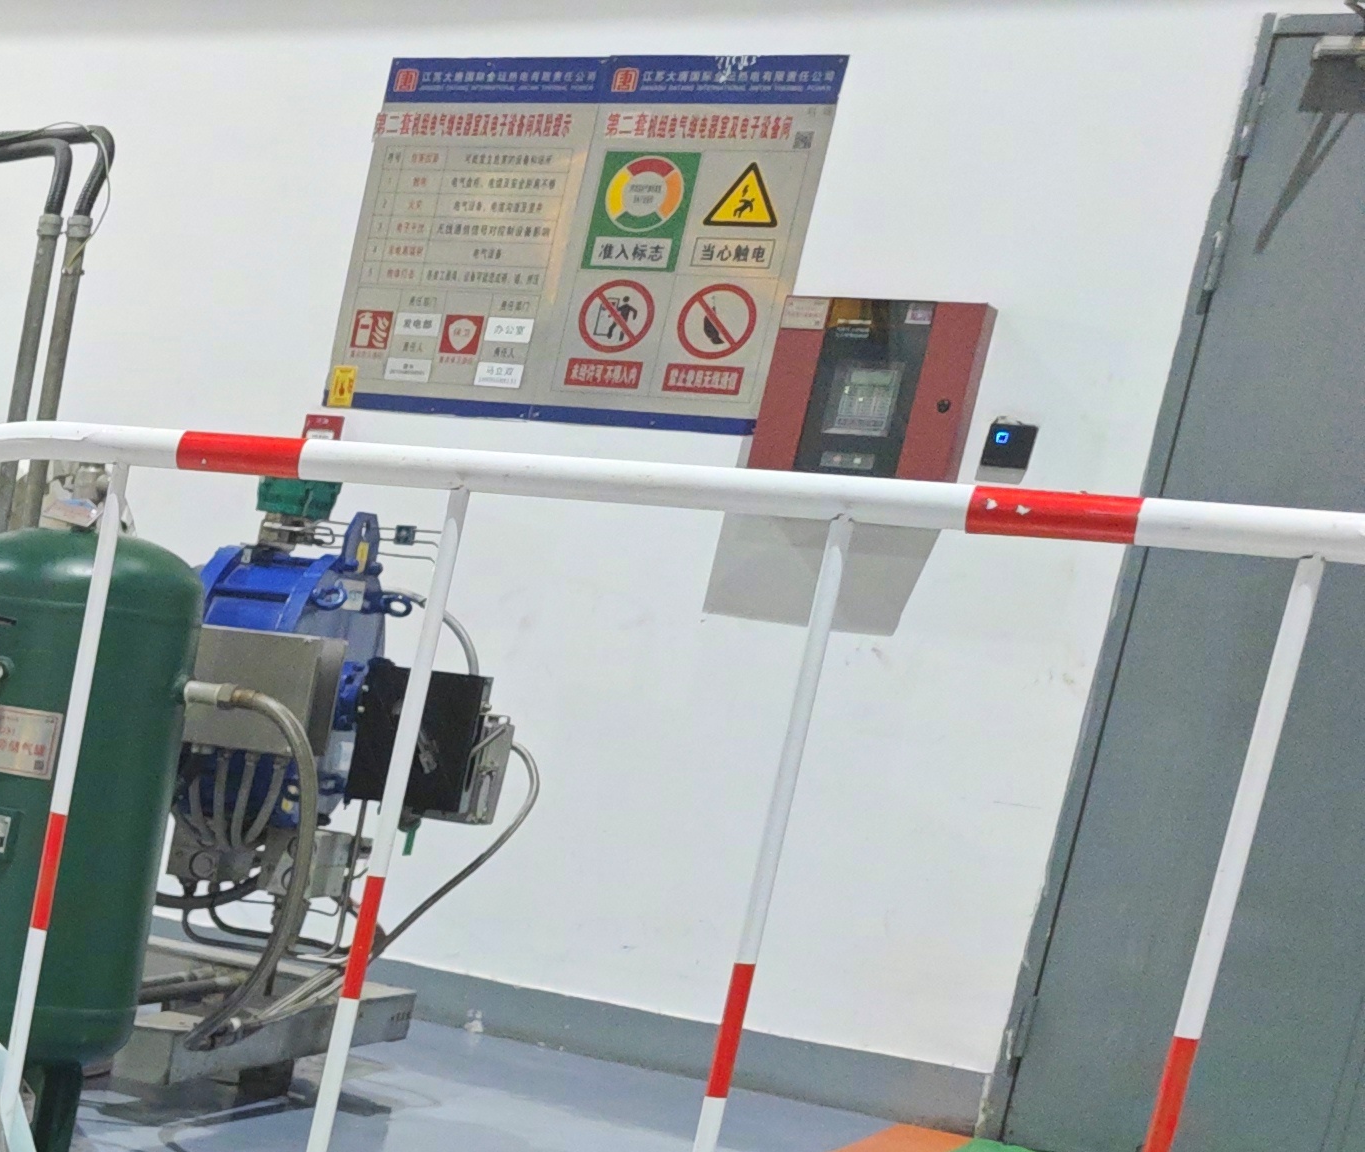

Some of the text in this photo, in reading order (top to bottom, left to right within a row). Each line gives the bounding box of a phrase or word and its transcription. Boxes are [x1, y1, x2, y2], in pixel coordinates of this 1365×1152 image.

[598, 243, 665, 262] 准入标志
[699, 244, 766, 264] 当心触电
[403, 318, 433, 329] 发电部
[493, 324, 526, 336] 办公室
